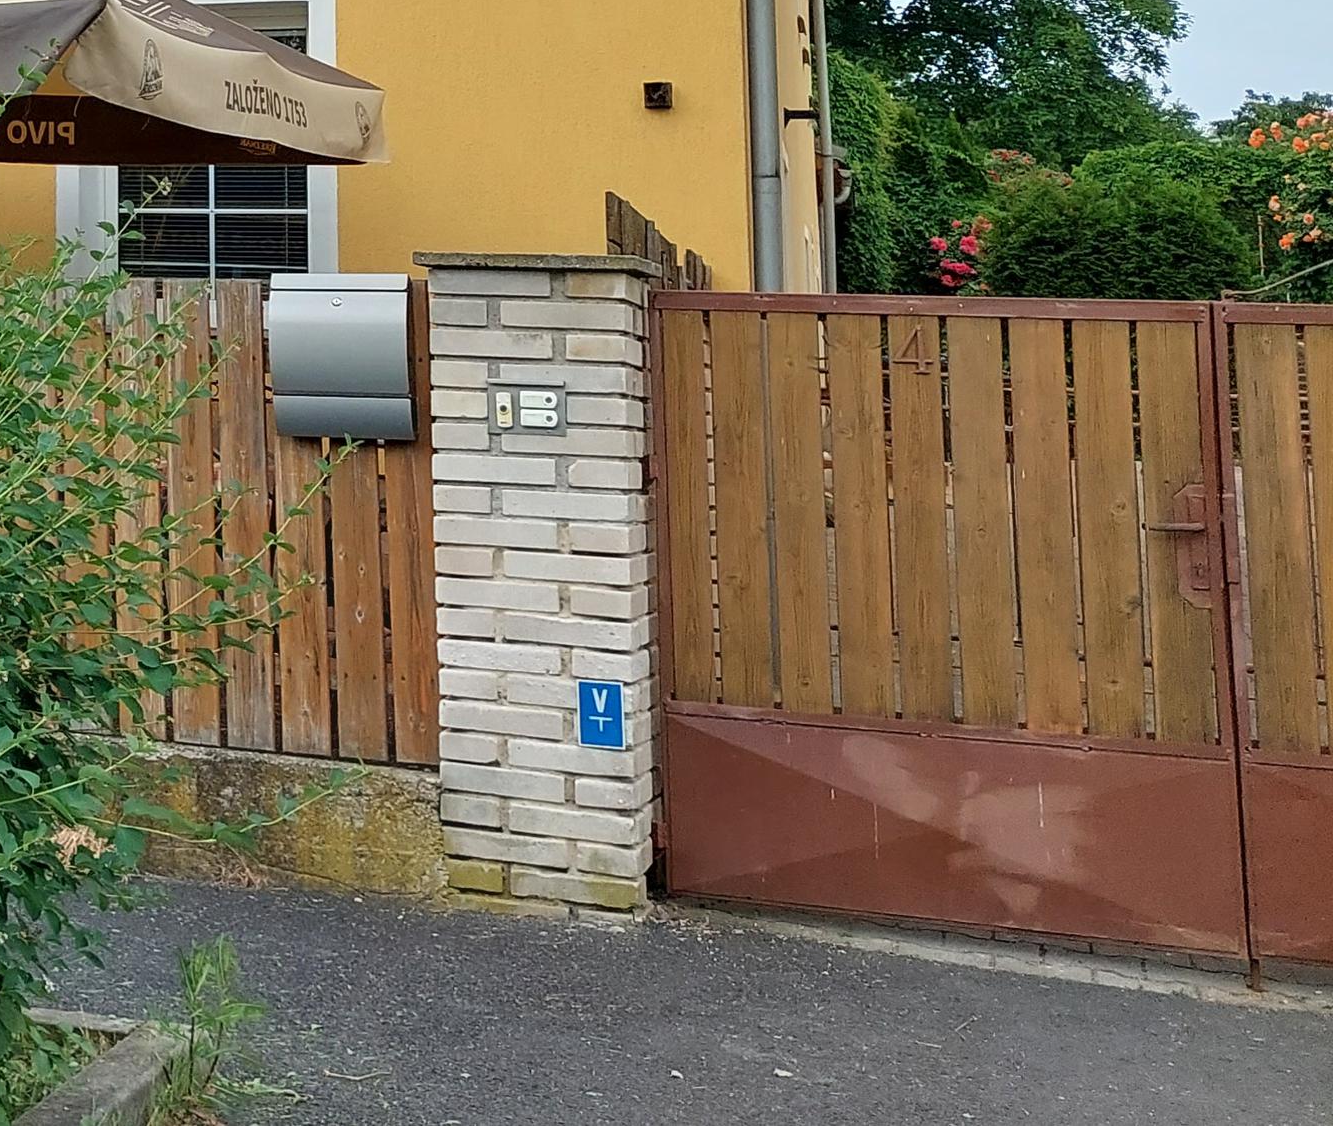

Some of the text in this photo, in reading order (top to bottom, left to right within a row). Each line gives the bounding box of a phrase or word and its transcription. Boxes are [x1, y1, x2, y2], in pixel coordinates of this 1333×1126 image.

[225, 79, 308, 128] ZALOŽENO 1753
[893, 325, 934, 375] 4
[592, 688, 608, 714] V
